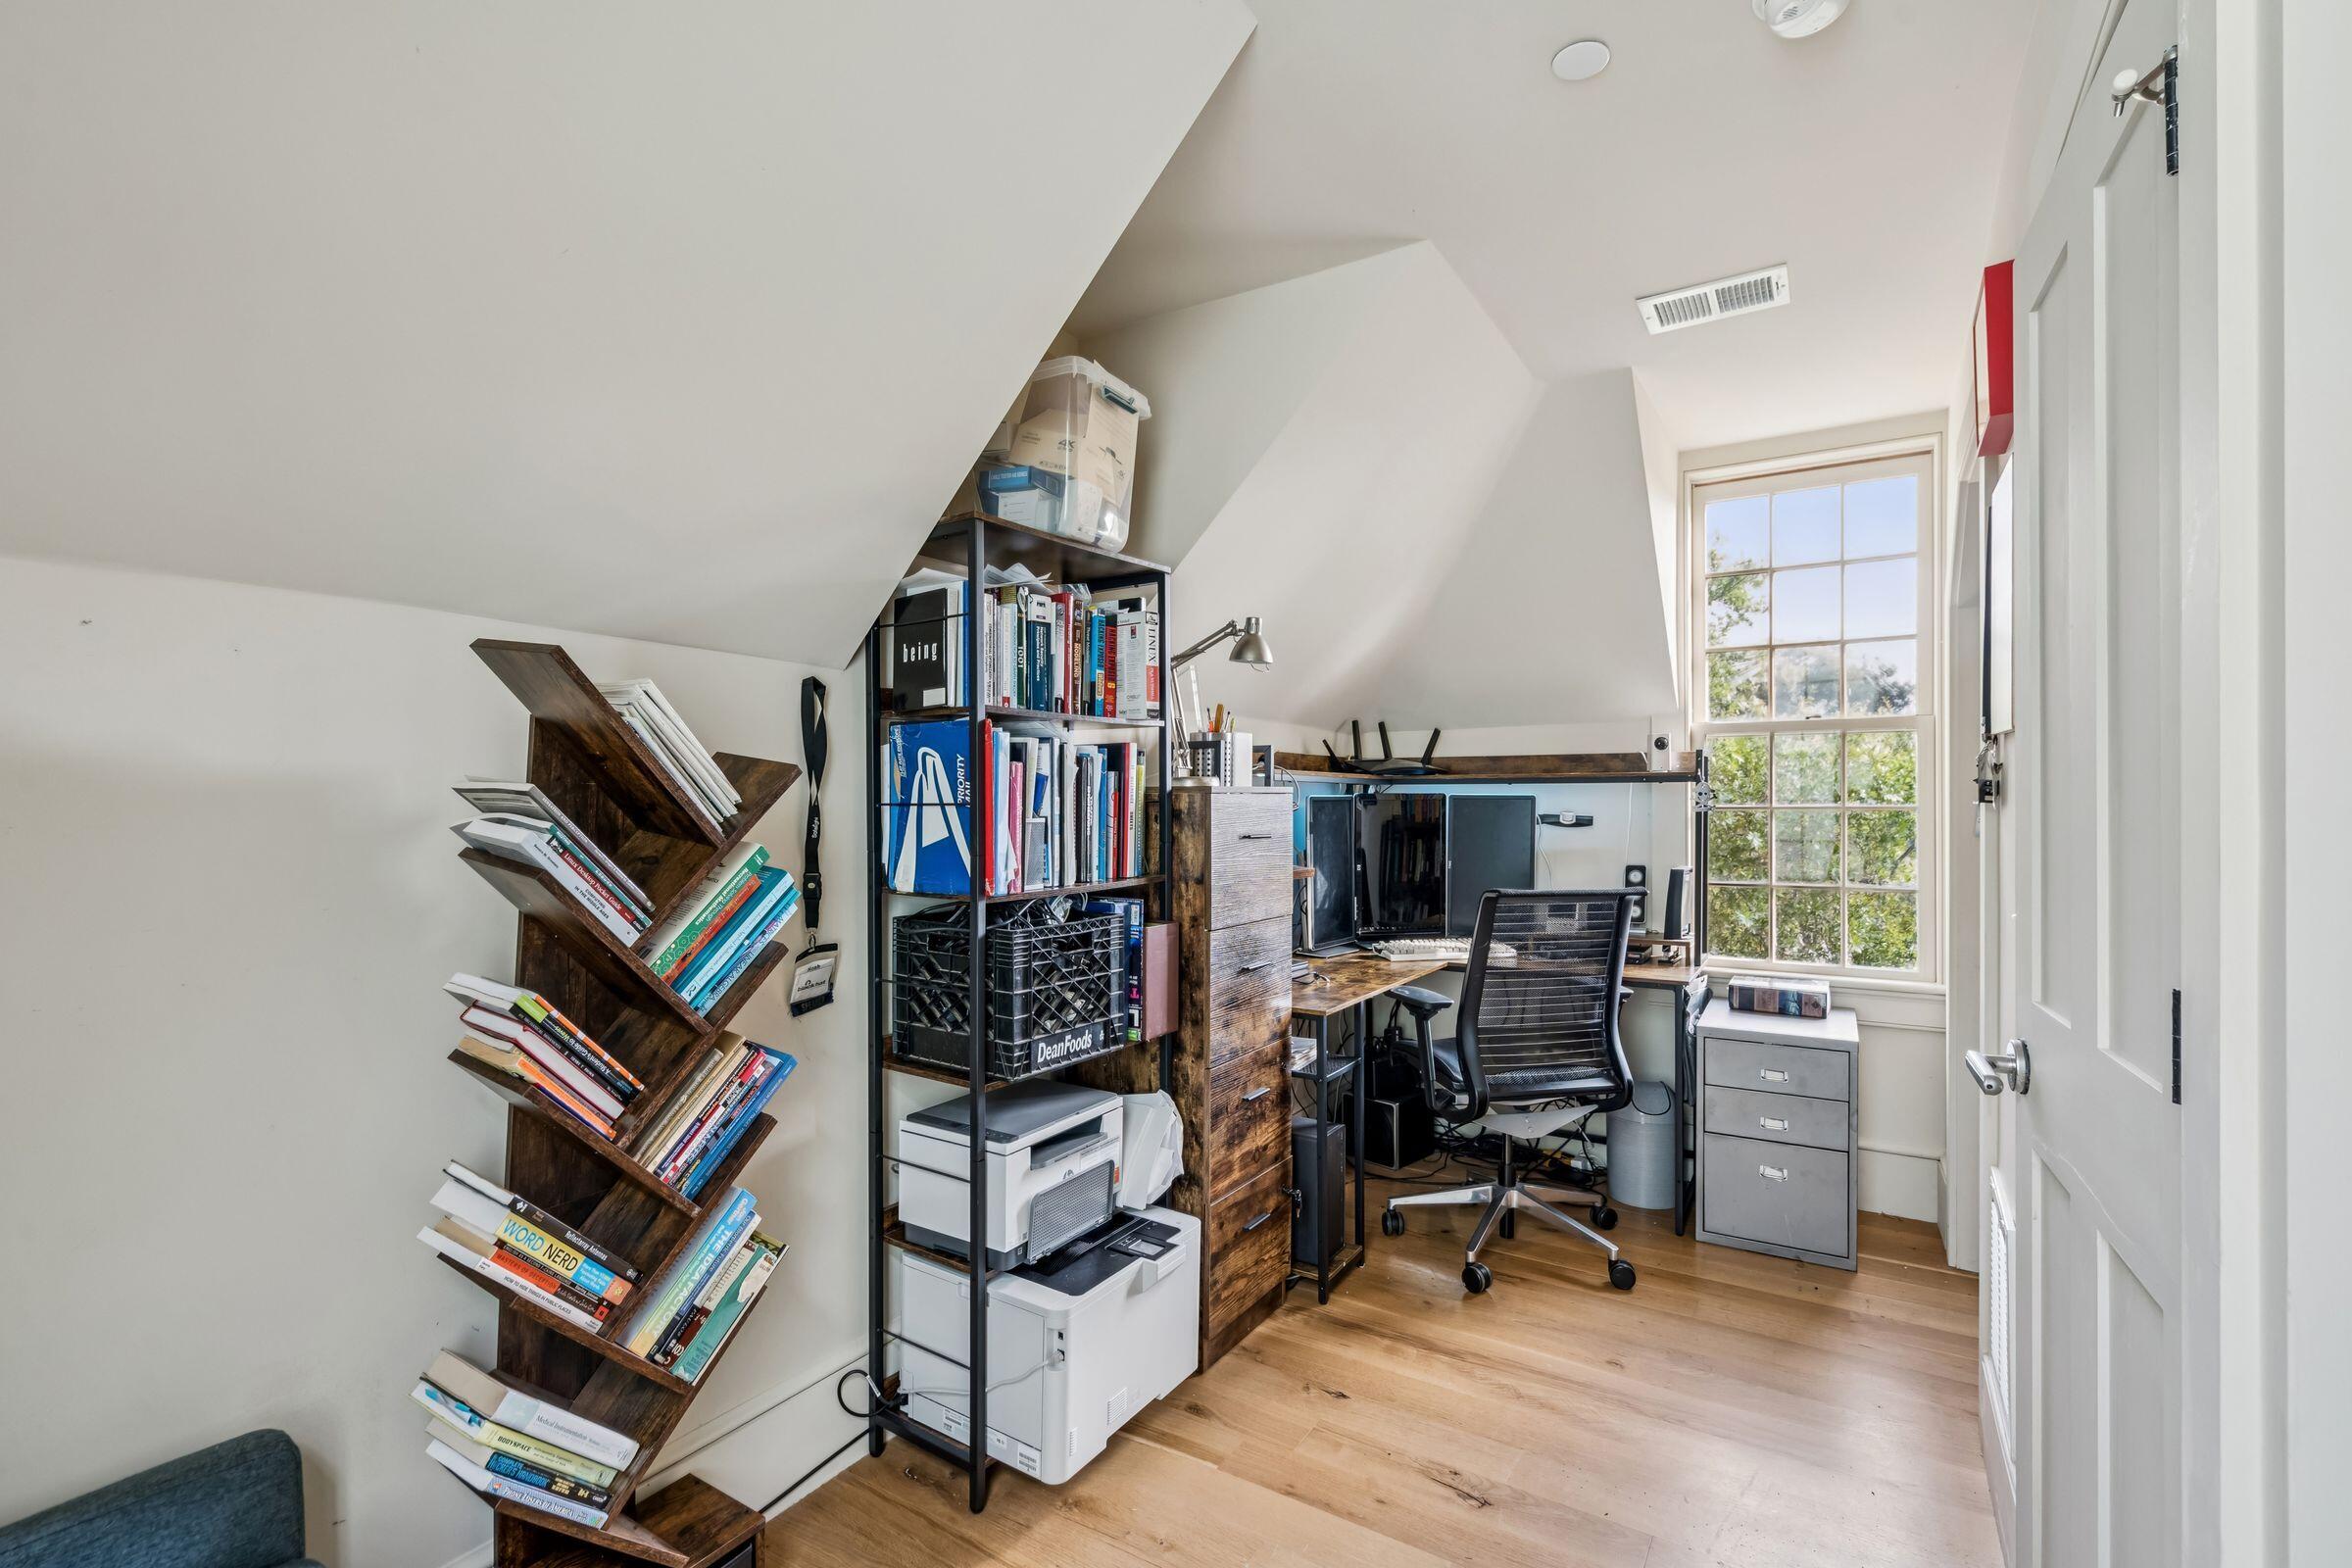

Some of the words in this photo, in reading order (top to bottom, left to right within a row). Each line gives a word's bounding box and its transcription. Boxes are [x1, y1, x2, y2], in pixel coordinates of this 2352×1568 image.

[903, 641, 938, 663] being
[564, 853, 578, 867] Linux
[575, 864, 596, 886] Desktop
[594, 882, 611, 899] Pocket
[608, 895, 622, 910] Guide
[720, 866, 749, 898] Recreational
[694, 894, 723, 927] Mathematics
[732, 951, 755, 973] LINEAR
[707, 971, 737, 1003] ALGEBRA
[552, 1024, 570, 1043] Waves
[571, 1041, 588, 1056] Guide
[1037, 1029, 1093, 1063] DeanFoods
[584, 1051, 608, 1073] Student's
[501, 1217, 547, 1253] WORD
[541, 1241, 580, 1273] NERD
[563, 1229, 592, 1252] Reflectarray
[587, 1243, 610, 1261] Antennas
[710, 1227, 733, 1253] THE
[690, 1251, 715, 1282] IDEA
[503, 1275, 514, 1285] HOW
[517, 1283, 529, 1292] HIDE
[527, 1288, 541, 1298] THINGS
[544, 1297, 559, 1307] PUBLIC
[557, 1303, 571, 1315] PLACES
[649, 1280, 695, 1339] FACTORY
[535, 1414, 555, 1427] Medical
[496, 1435, 532, 1452] BODYSPACE
[502, 1485, 524, 1500] PHONE
[548, 1500, 574, 1517] AMERICA
